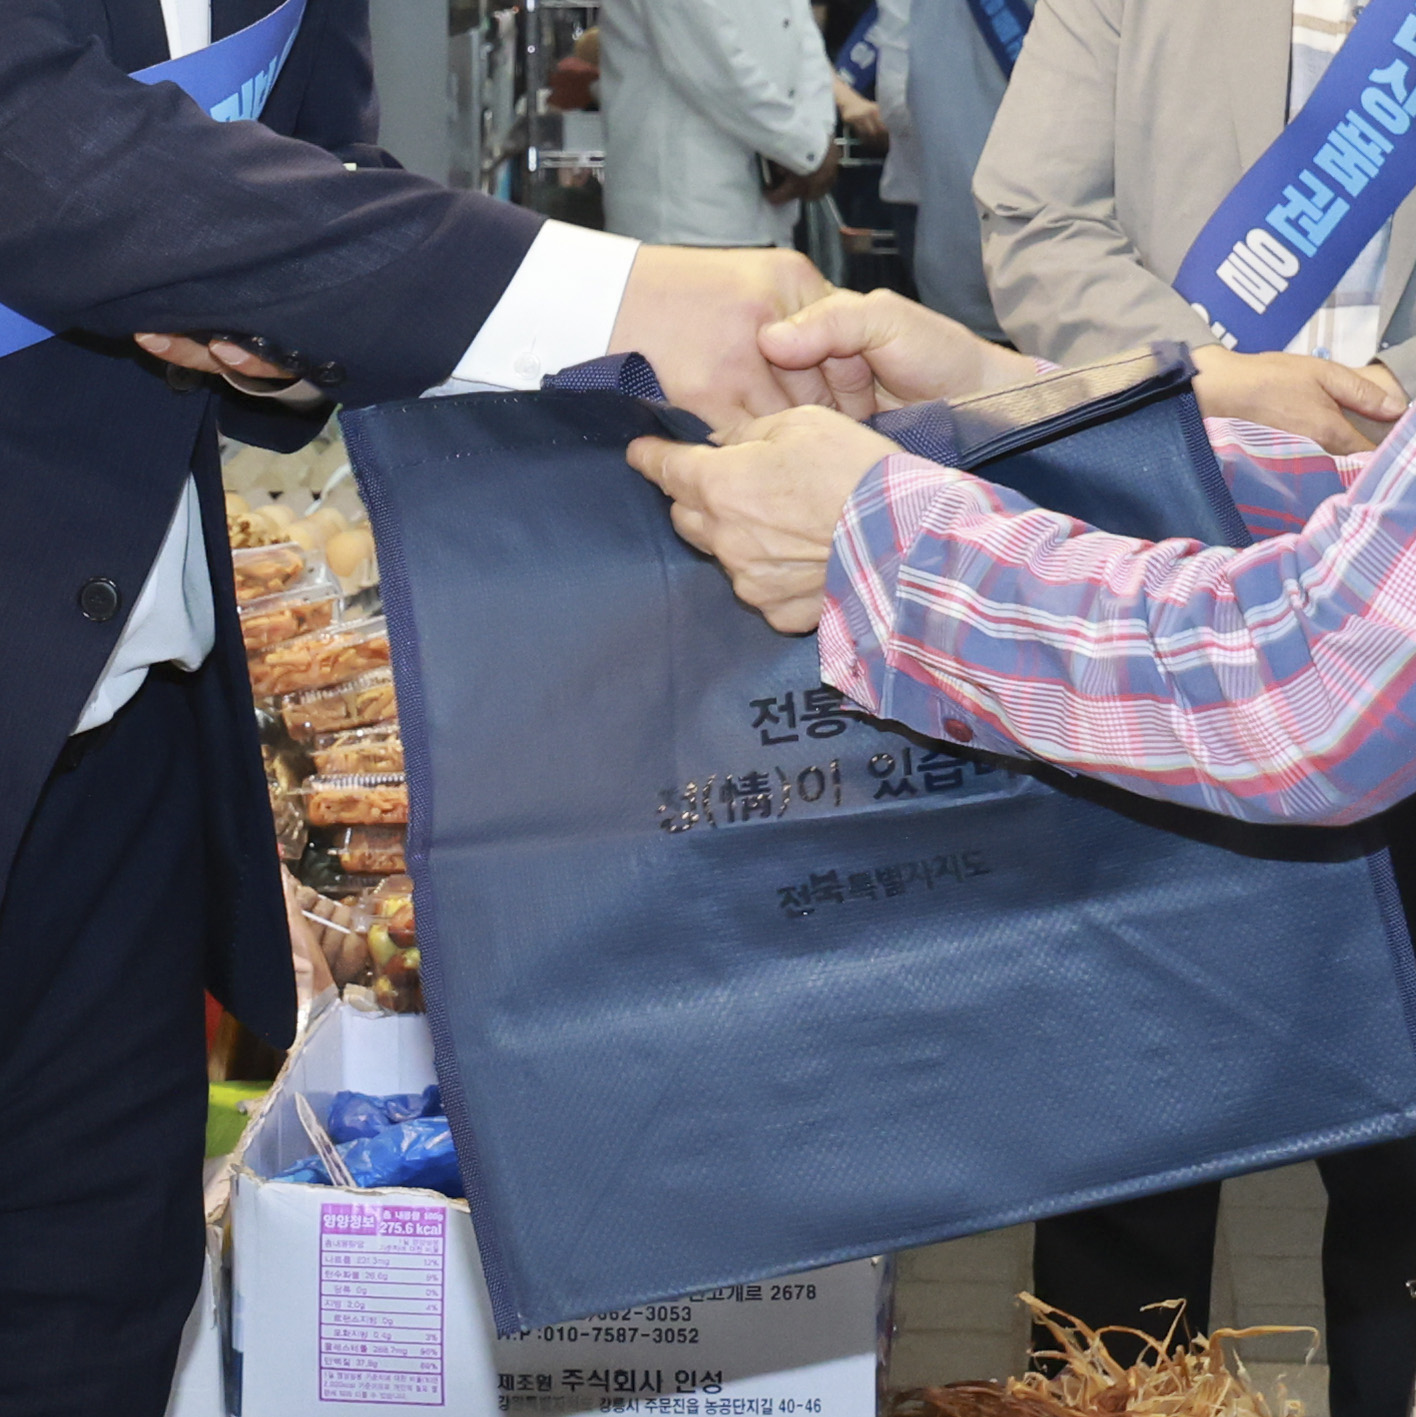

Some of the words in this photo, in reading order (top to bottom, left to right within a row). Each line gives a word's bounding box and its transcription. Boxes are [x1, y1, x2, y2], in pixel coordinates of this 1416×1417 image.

[749, 688, 848, 747] 전통
[776, 849, 990, 916] 전북특별자치도
[323, 1214, 375, 1229] 영양정보
[379, 1222, 413, 1234] 275.6
[416, 1222, 442, 1236] kcal
[771, 1285, 817, 1301] 2678
[497, 1373, 553, 1392] 제조원
[561, 1369, 663, 1394] 주식회사
[675, 1369, 724, 1395] 인성
[600, 1397, 640, 1414] 강릉시
[644, 1398, 699, 1415] 주문진읍
[704, 1398, 773, 1415] 농공단지길
[778, 1398, 822, 1414] 40-46
